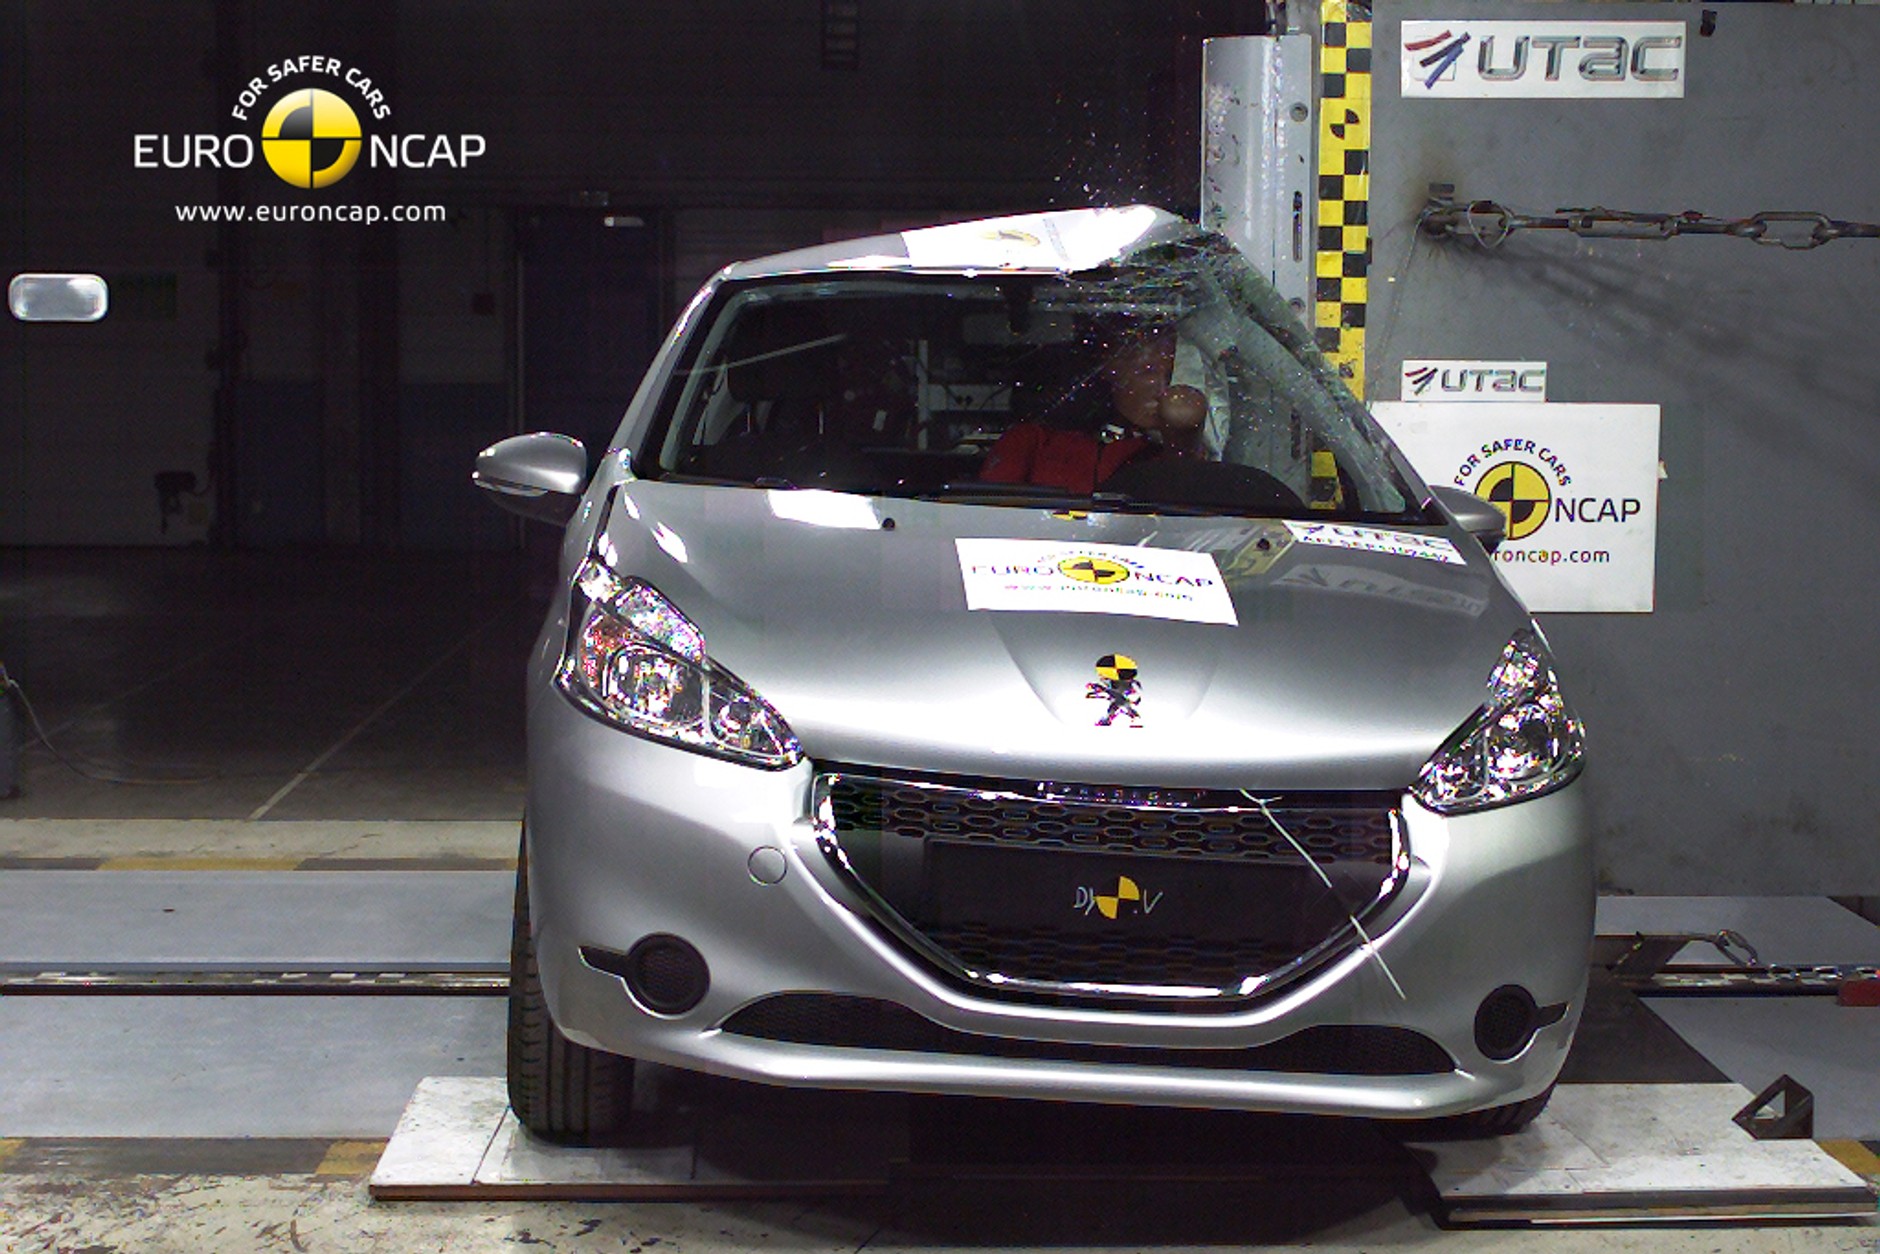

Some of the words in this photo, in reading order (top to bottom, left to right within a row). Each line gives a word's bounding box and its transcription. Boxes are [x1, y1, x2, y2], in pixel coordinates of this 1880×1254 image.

[1454, 453, 1481, 486] FOR
[1481, 438, 1536, 459] SAFER
[1538, 447, 1572, 486] CARS
[1554, 497, 1641, 523] NCAP
[1490, 549, 1610, 567] roncap.com
[1134, 570, 1214, 588] NCAP
